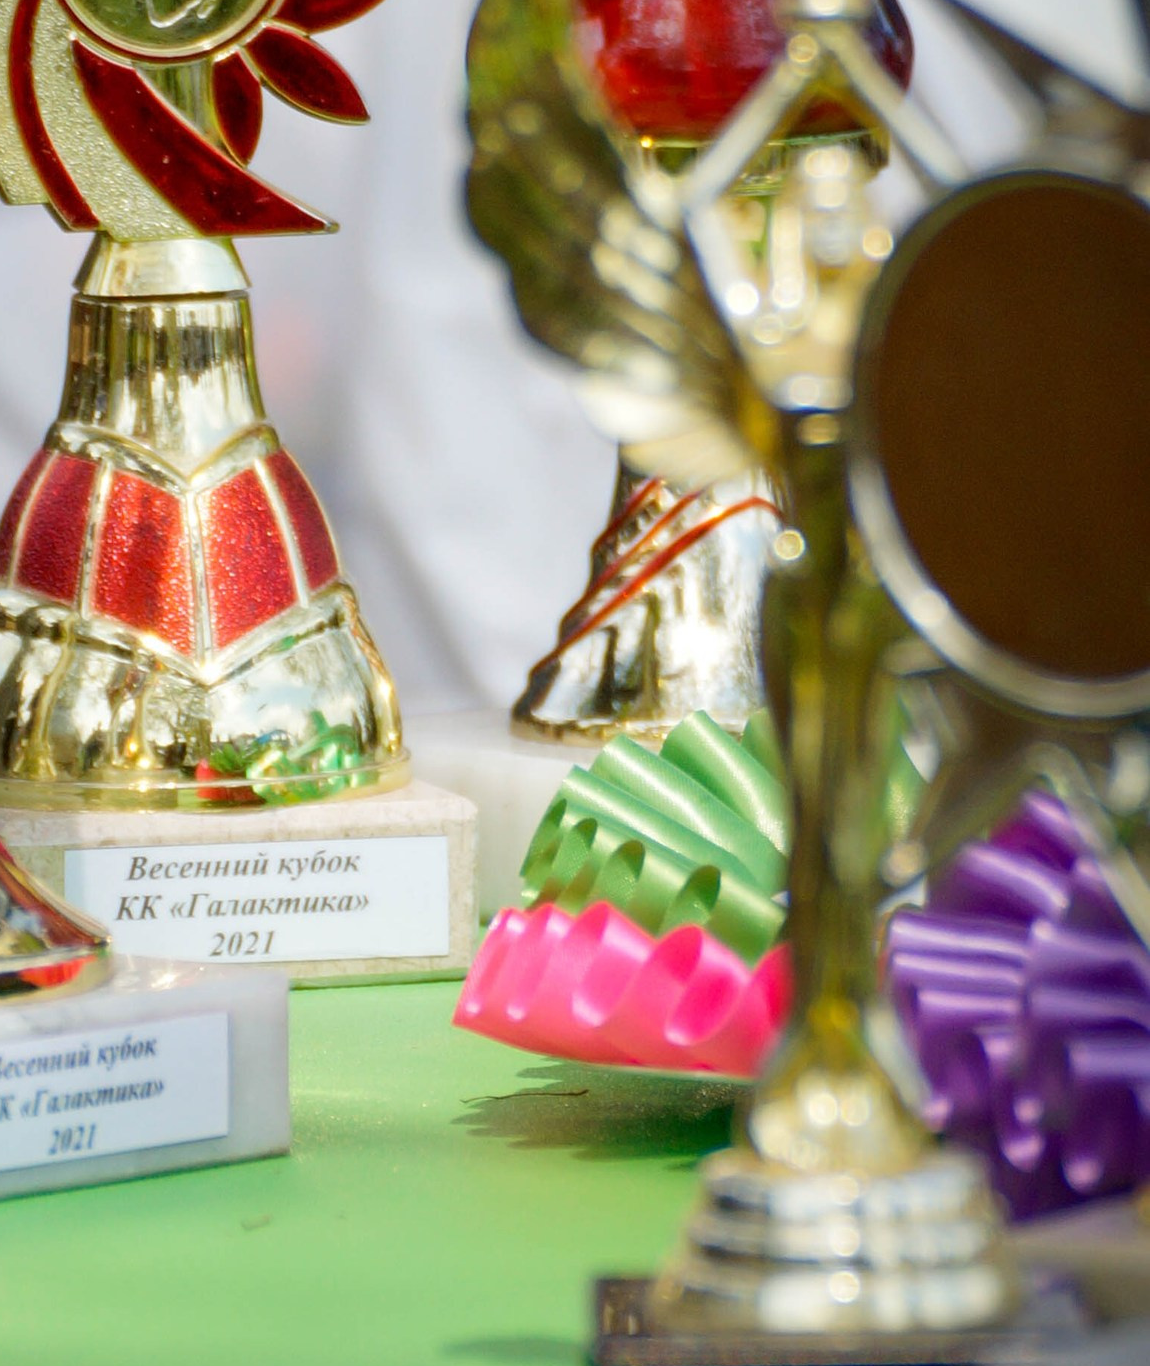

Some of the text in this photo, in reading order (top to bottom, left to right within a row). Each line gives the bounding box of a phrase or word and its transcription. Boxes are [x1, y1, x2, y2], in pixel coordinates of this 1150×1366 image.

[126, 849, 360, 882] Весенний кубок
[115, 892, 369, 921] КК «Галактика»
[209, 930, 276, 957] 2021
[97, 1033, 158, 1071] кубок
[20, 1078, 165, 1117] «Галактика»
[47, 1123, 97, 1156] 2021
